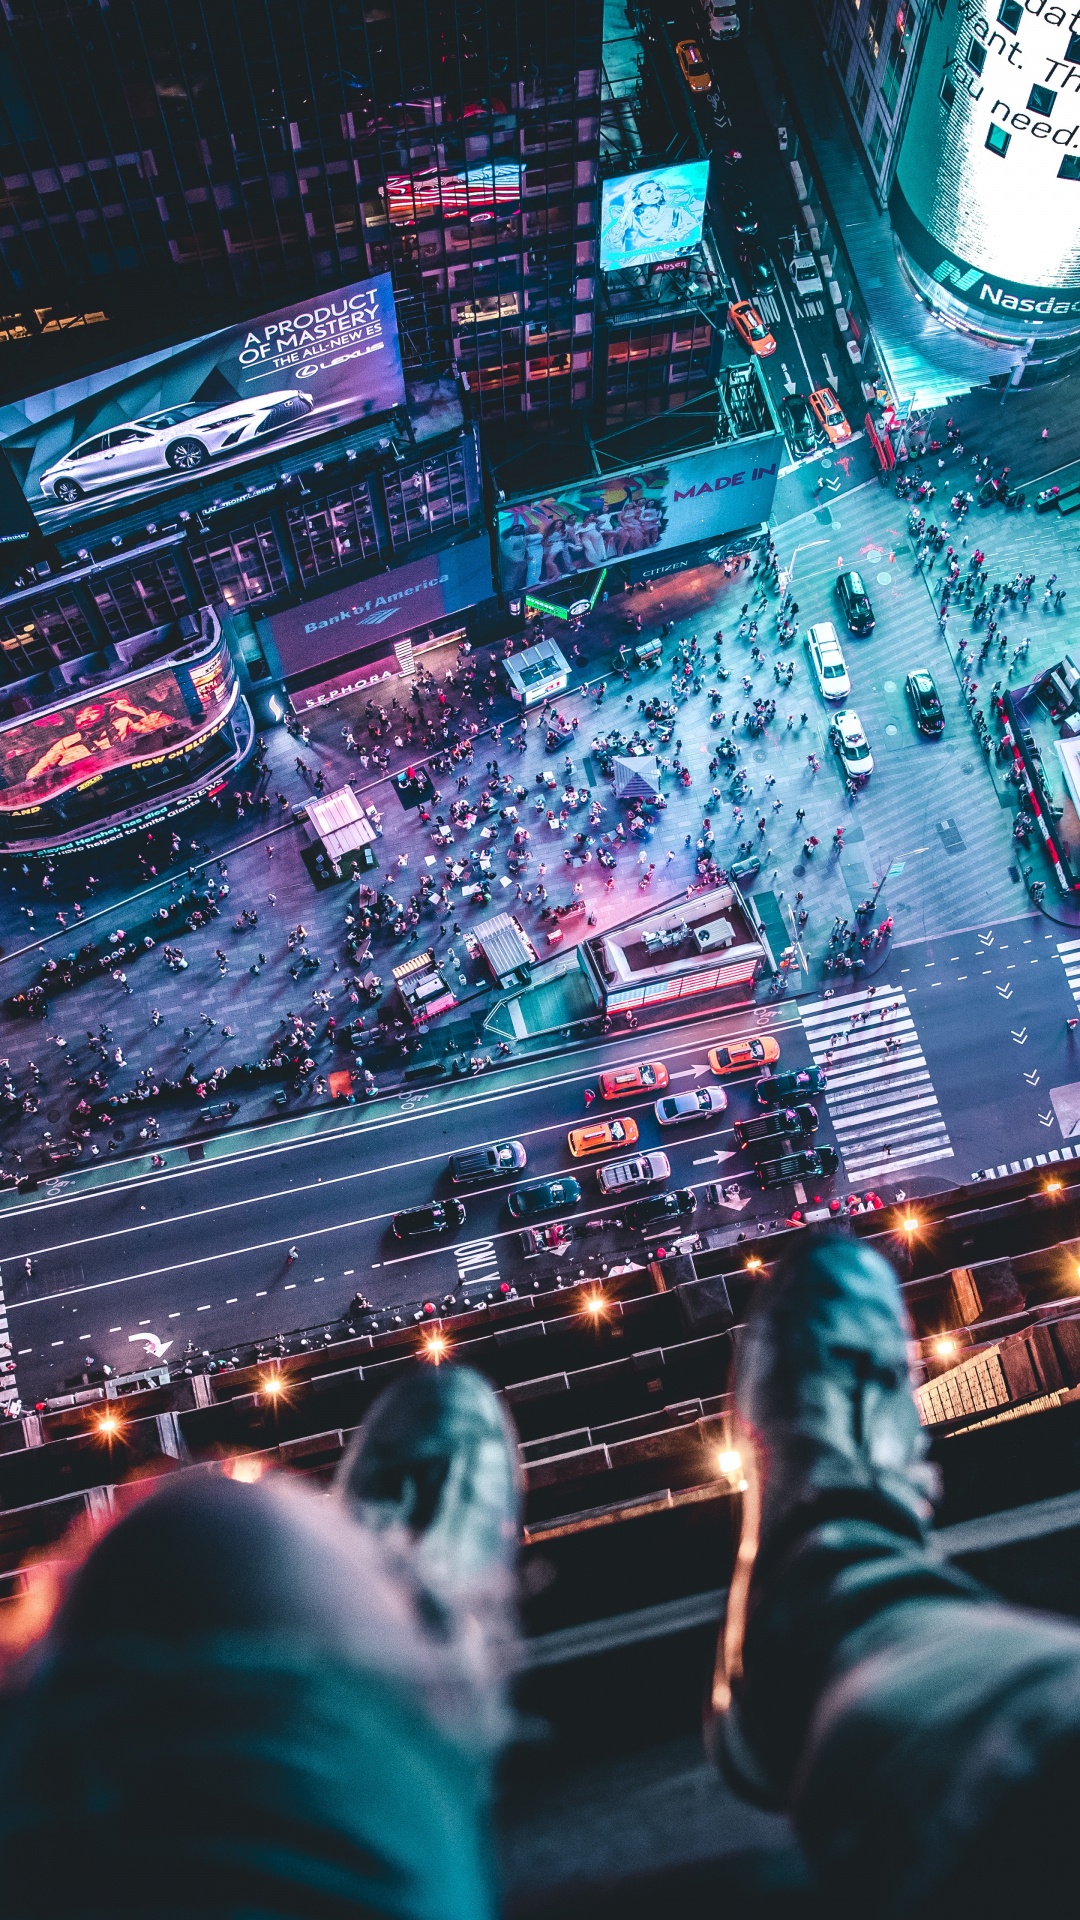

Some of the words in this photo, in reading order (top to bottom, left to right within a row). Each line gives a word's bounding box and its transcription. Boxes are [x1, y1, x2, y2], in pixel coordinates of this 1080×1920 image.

[990, 99, 1080, 149] need.
[655, 261, 687, 272] Absen
[239, 342, 271, 364] OF
[276, 303, 380, 353] MASTERY
[244, 332, 261, 349] A
[264, 288, 378, 341] PRODUCT
[272, 353, 300, 368] THE
[302, 329, 363, 358] ALL-NEW
[366, 322, 383, 336] ES
[320, 341, 385, 369] LEXUS
[673, 471, 746, 502] MADE
[751, 463, 777, 480] IN
[642, 560, 689, 578] CITIZEN
[304, 611, 351, 634] Bank
[352, 600, 373, 616] of
[374, 572, 449, 608] America
[305, 670, 392, 708] SEPHORA
[12, 806, 41, 816] AND
[131, 755, 166, 770] NOW
[168, 749, 184, 760] ON
[186, 777, 224, 802] NEWS
[144, 806, 168, 820] died
[86, 832, 124, 849] helped
[125, 828, 137, 836] to
[453, 1241, 501, 1286] ONLY
